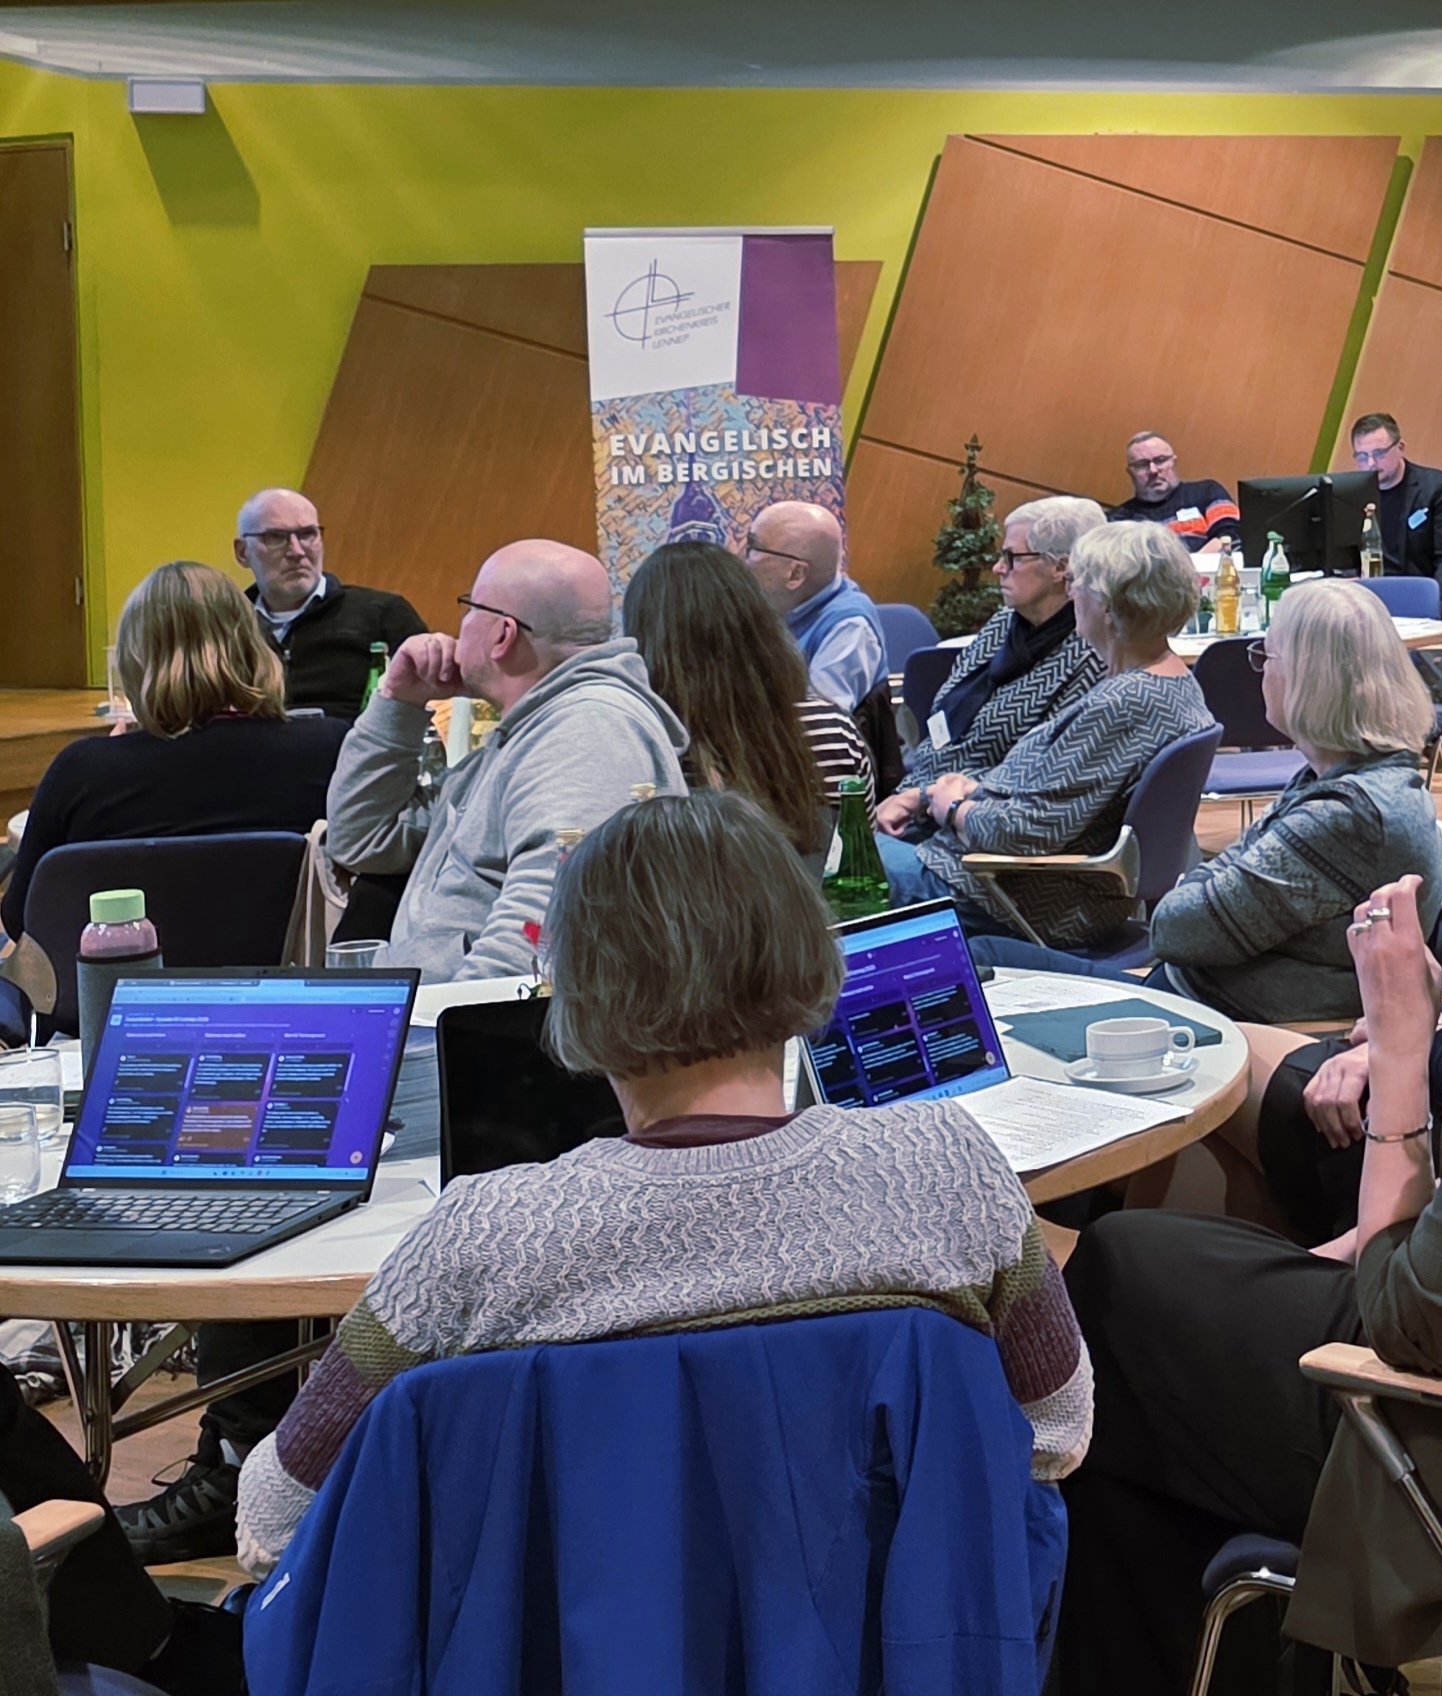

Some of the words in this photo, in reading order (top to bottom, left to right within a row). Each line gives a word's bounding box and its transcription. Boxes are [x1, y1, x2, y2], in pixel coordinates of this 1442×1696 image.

[610, 427, 831, 456] EVANGELISCH
[611, 464, 646, 485] IM
[658, 458, 832, 483] BERGISCHEN
